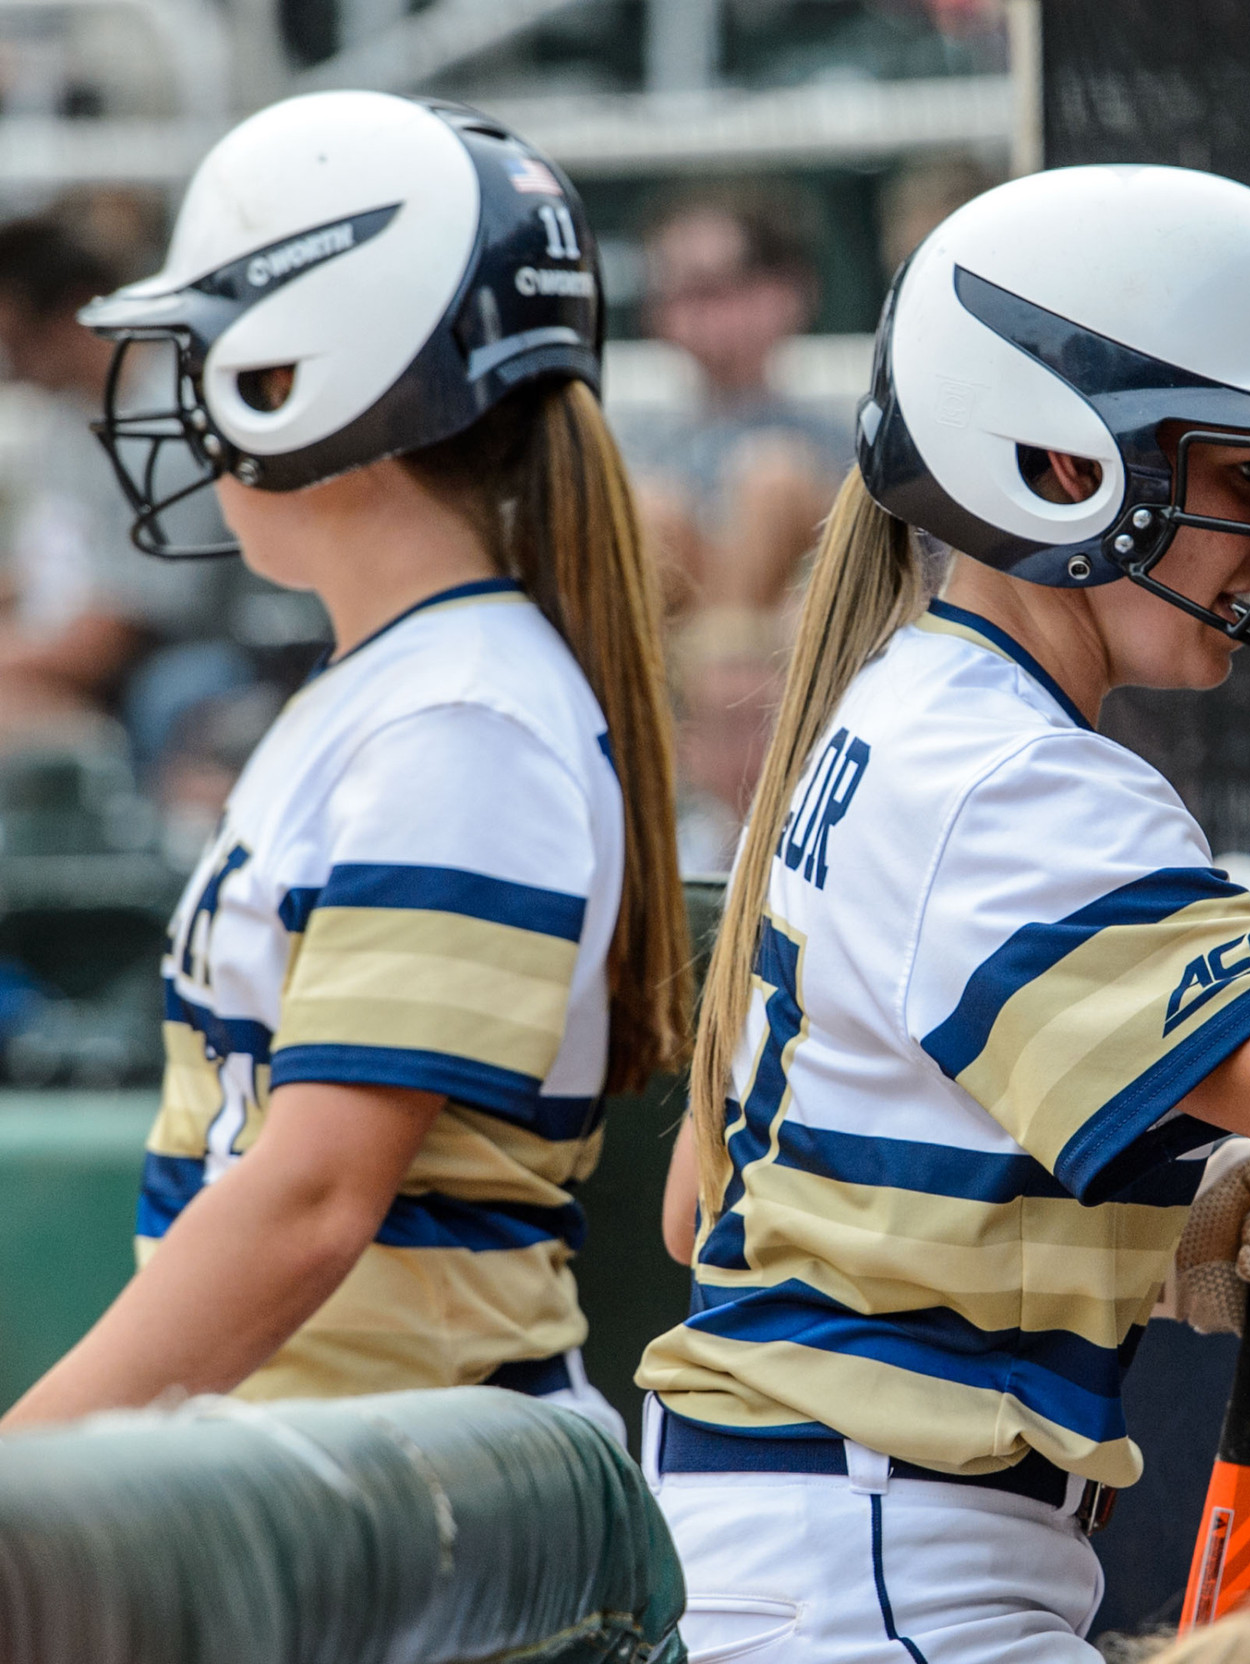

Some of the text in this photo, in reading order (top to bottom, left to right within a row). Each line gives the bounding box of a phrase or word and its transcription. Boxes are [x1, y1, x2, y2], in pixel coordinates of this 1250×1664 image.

[267, 222, 355, 278] WORTH
[538, 205, 581, 260] 11
[775, 727, 871, 891] OR
